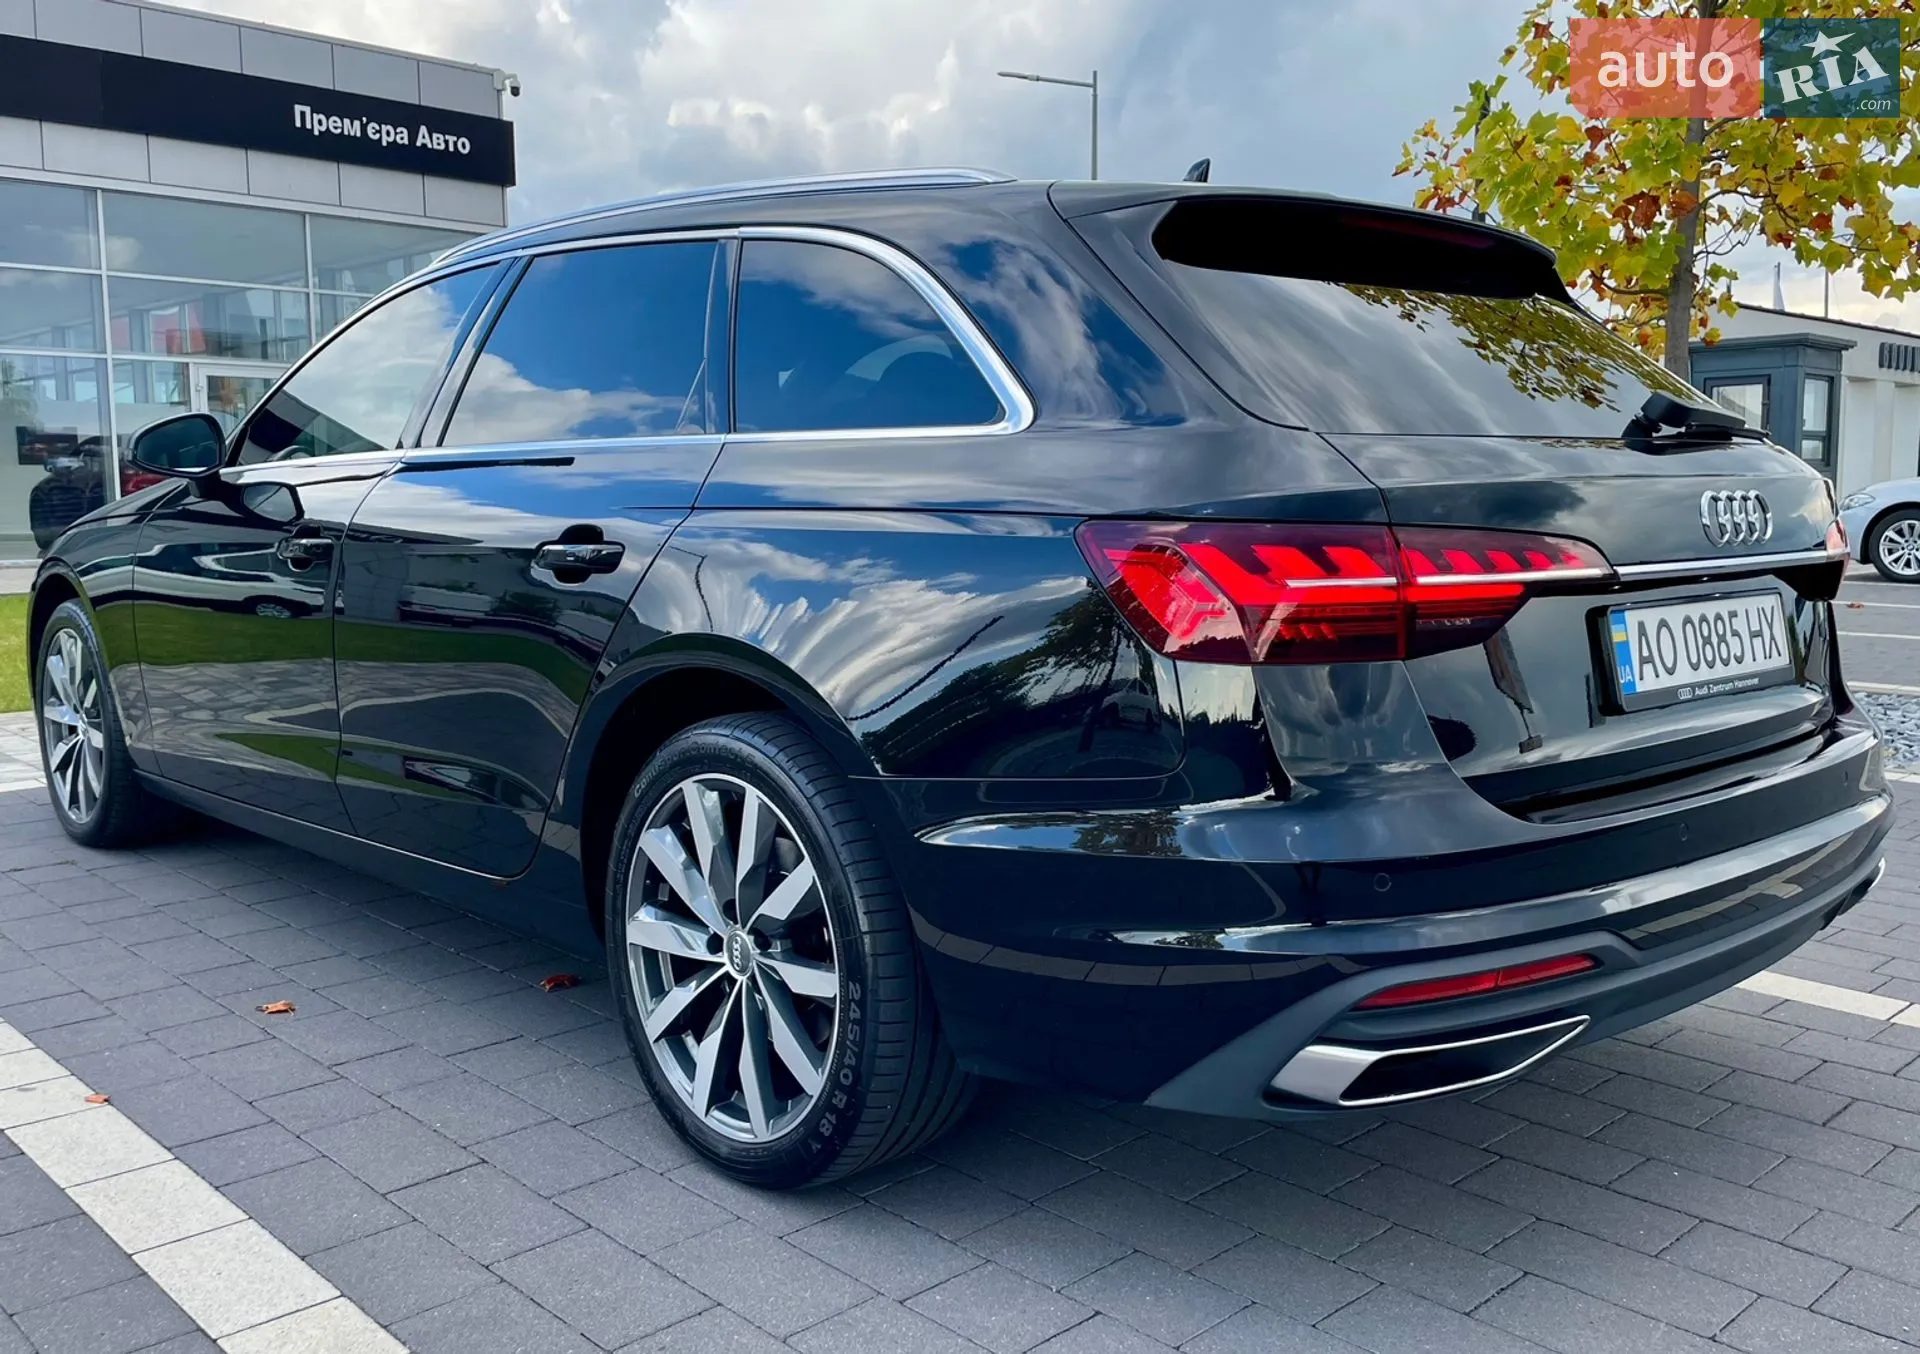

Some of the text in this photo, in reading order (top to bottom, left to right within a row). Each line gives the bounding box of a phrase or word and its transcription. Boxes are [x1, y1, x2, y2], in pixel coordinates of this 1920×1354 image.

[416, 125, 471, 154] Авто
[1637, 605, 1782, 681] AO 0885 HX
[1618, 666, 1634, 684] UA
[1695, 685, 1708, 696] Audi
[1709, 681, 1734, 693] Zentrum
[840, 980, 862, 1086] 245/40
[819, 1111, 836, 1137] 18
